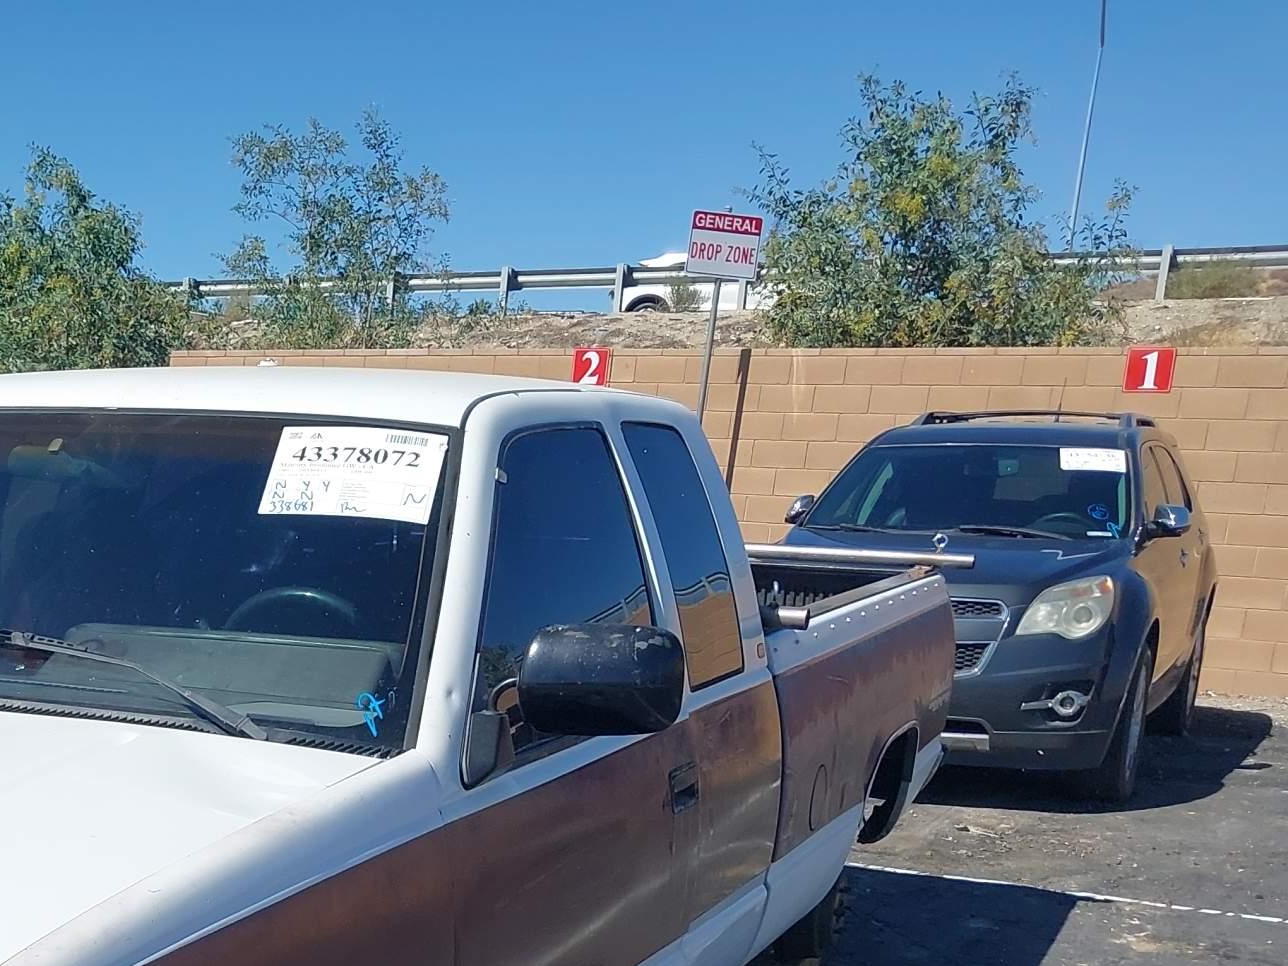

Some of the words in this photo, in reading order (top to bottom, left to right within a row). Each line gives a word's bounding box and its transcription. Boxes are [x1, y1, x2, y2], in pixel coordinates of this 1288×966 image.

[695, 213, 759, 233] GENERAL
[690, 242, 722, 261] DROP
[725, 245, 756, 265] ZONE
[578, 351, 601, 385] 2
[1136, 351, 1159, 389] 1
[292, 446, 421, 468] 43378072
